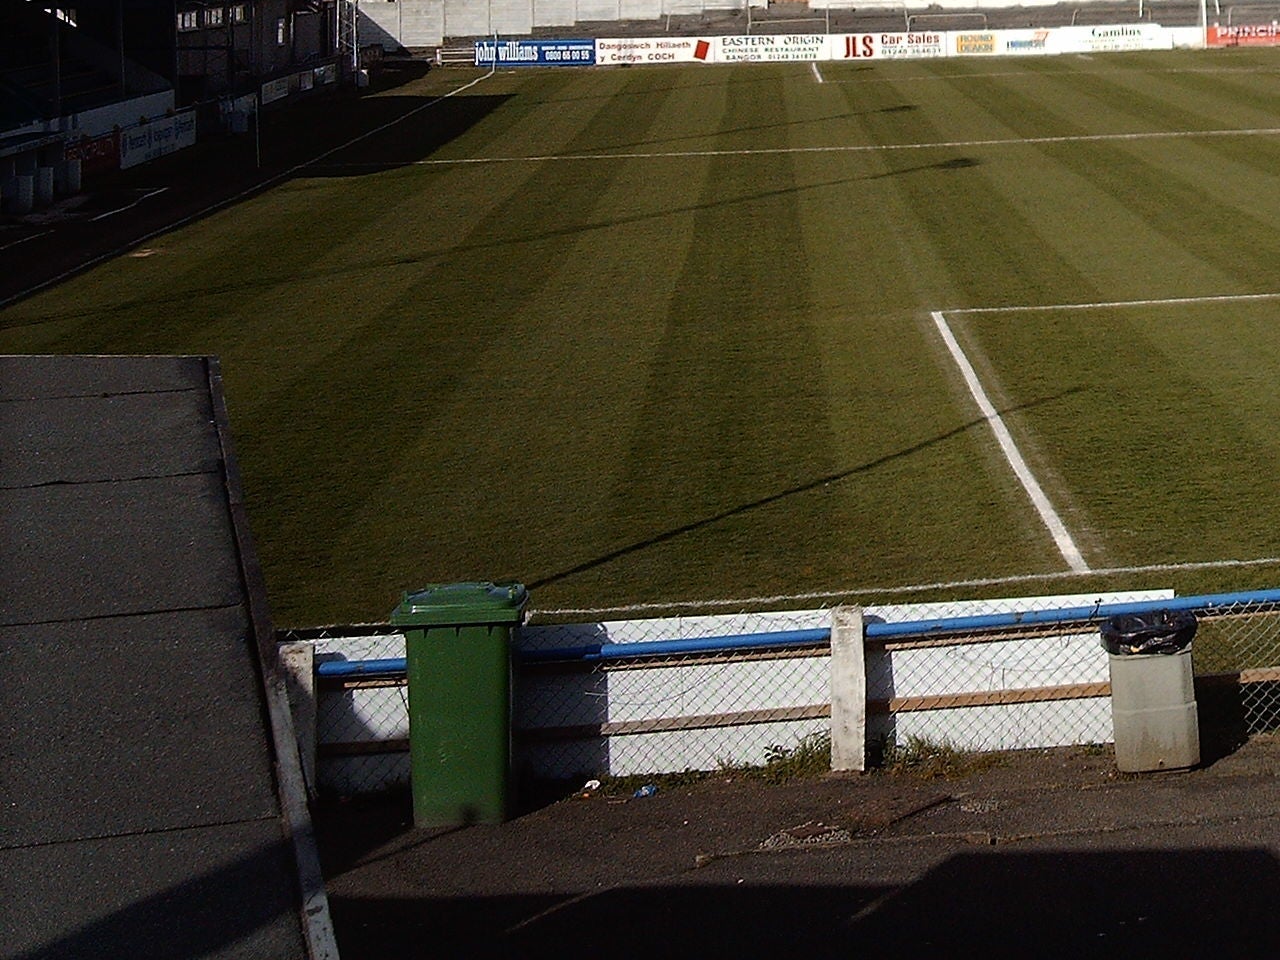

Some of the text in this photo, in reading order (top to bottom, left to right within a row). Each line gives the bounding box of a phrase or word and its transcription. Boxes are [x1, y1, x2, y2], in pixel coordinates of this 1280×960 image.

[722, 36, 824, 46] EASTERN ORIGIN
[881, 33, 940, 44] Car Sales
[498, 41, 538, 62] williams
[844, 35, 873, 58] JLS
[610, 53, 642, 62] Cerdyn
